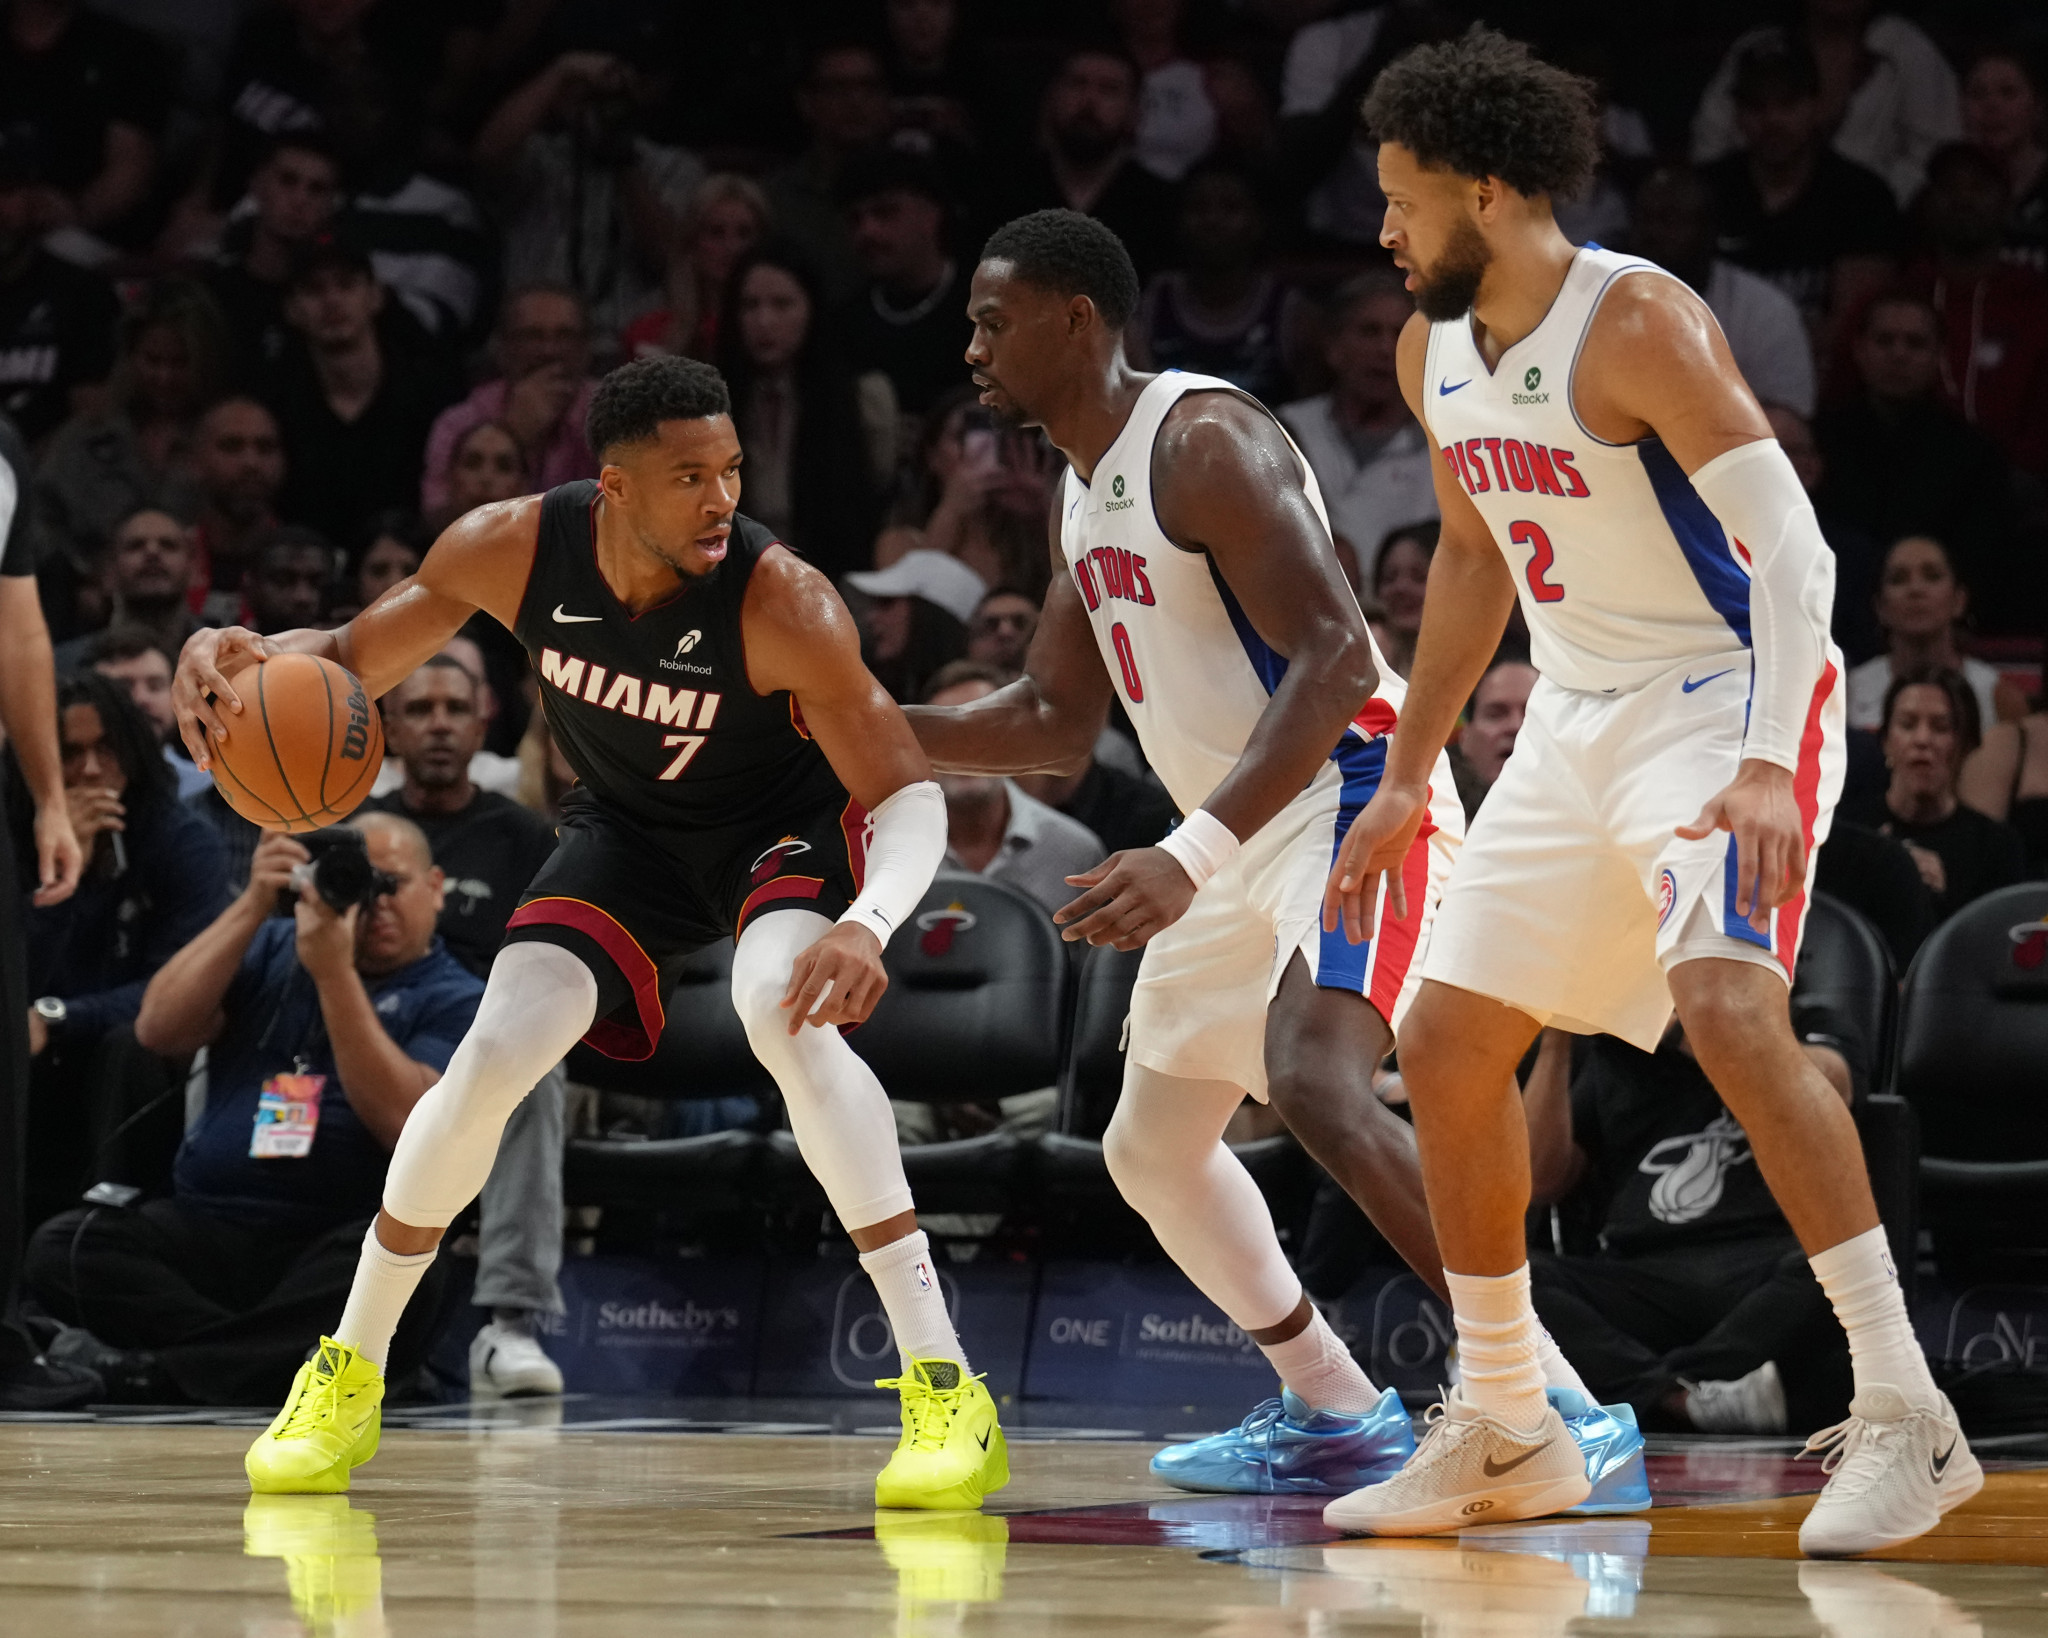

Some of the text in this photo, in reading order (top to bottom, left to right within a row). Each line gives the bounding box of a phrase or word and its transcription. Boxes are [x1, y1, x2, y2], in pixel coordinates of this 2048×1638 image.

[1511, 392, 1550, 405] StockX
[1105, 497, 1135, 512] StockX
[1508, 519, 1566, 603] 2
[659, 659, 712, 675] Robinhood
[1111, 621, 1144, 703] 0
[541, 646, 723, 731] MIAMI
[656, 734, 709, 782] 7
[597, 1301, 740, 1335] Sotheby's
[1050, 1313, 1257, 1354] ONE Sotheby
